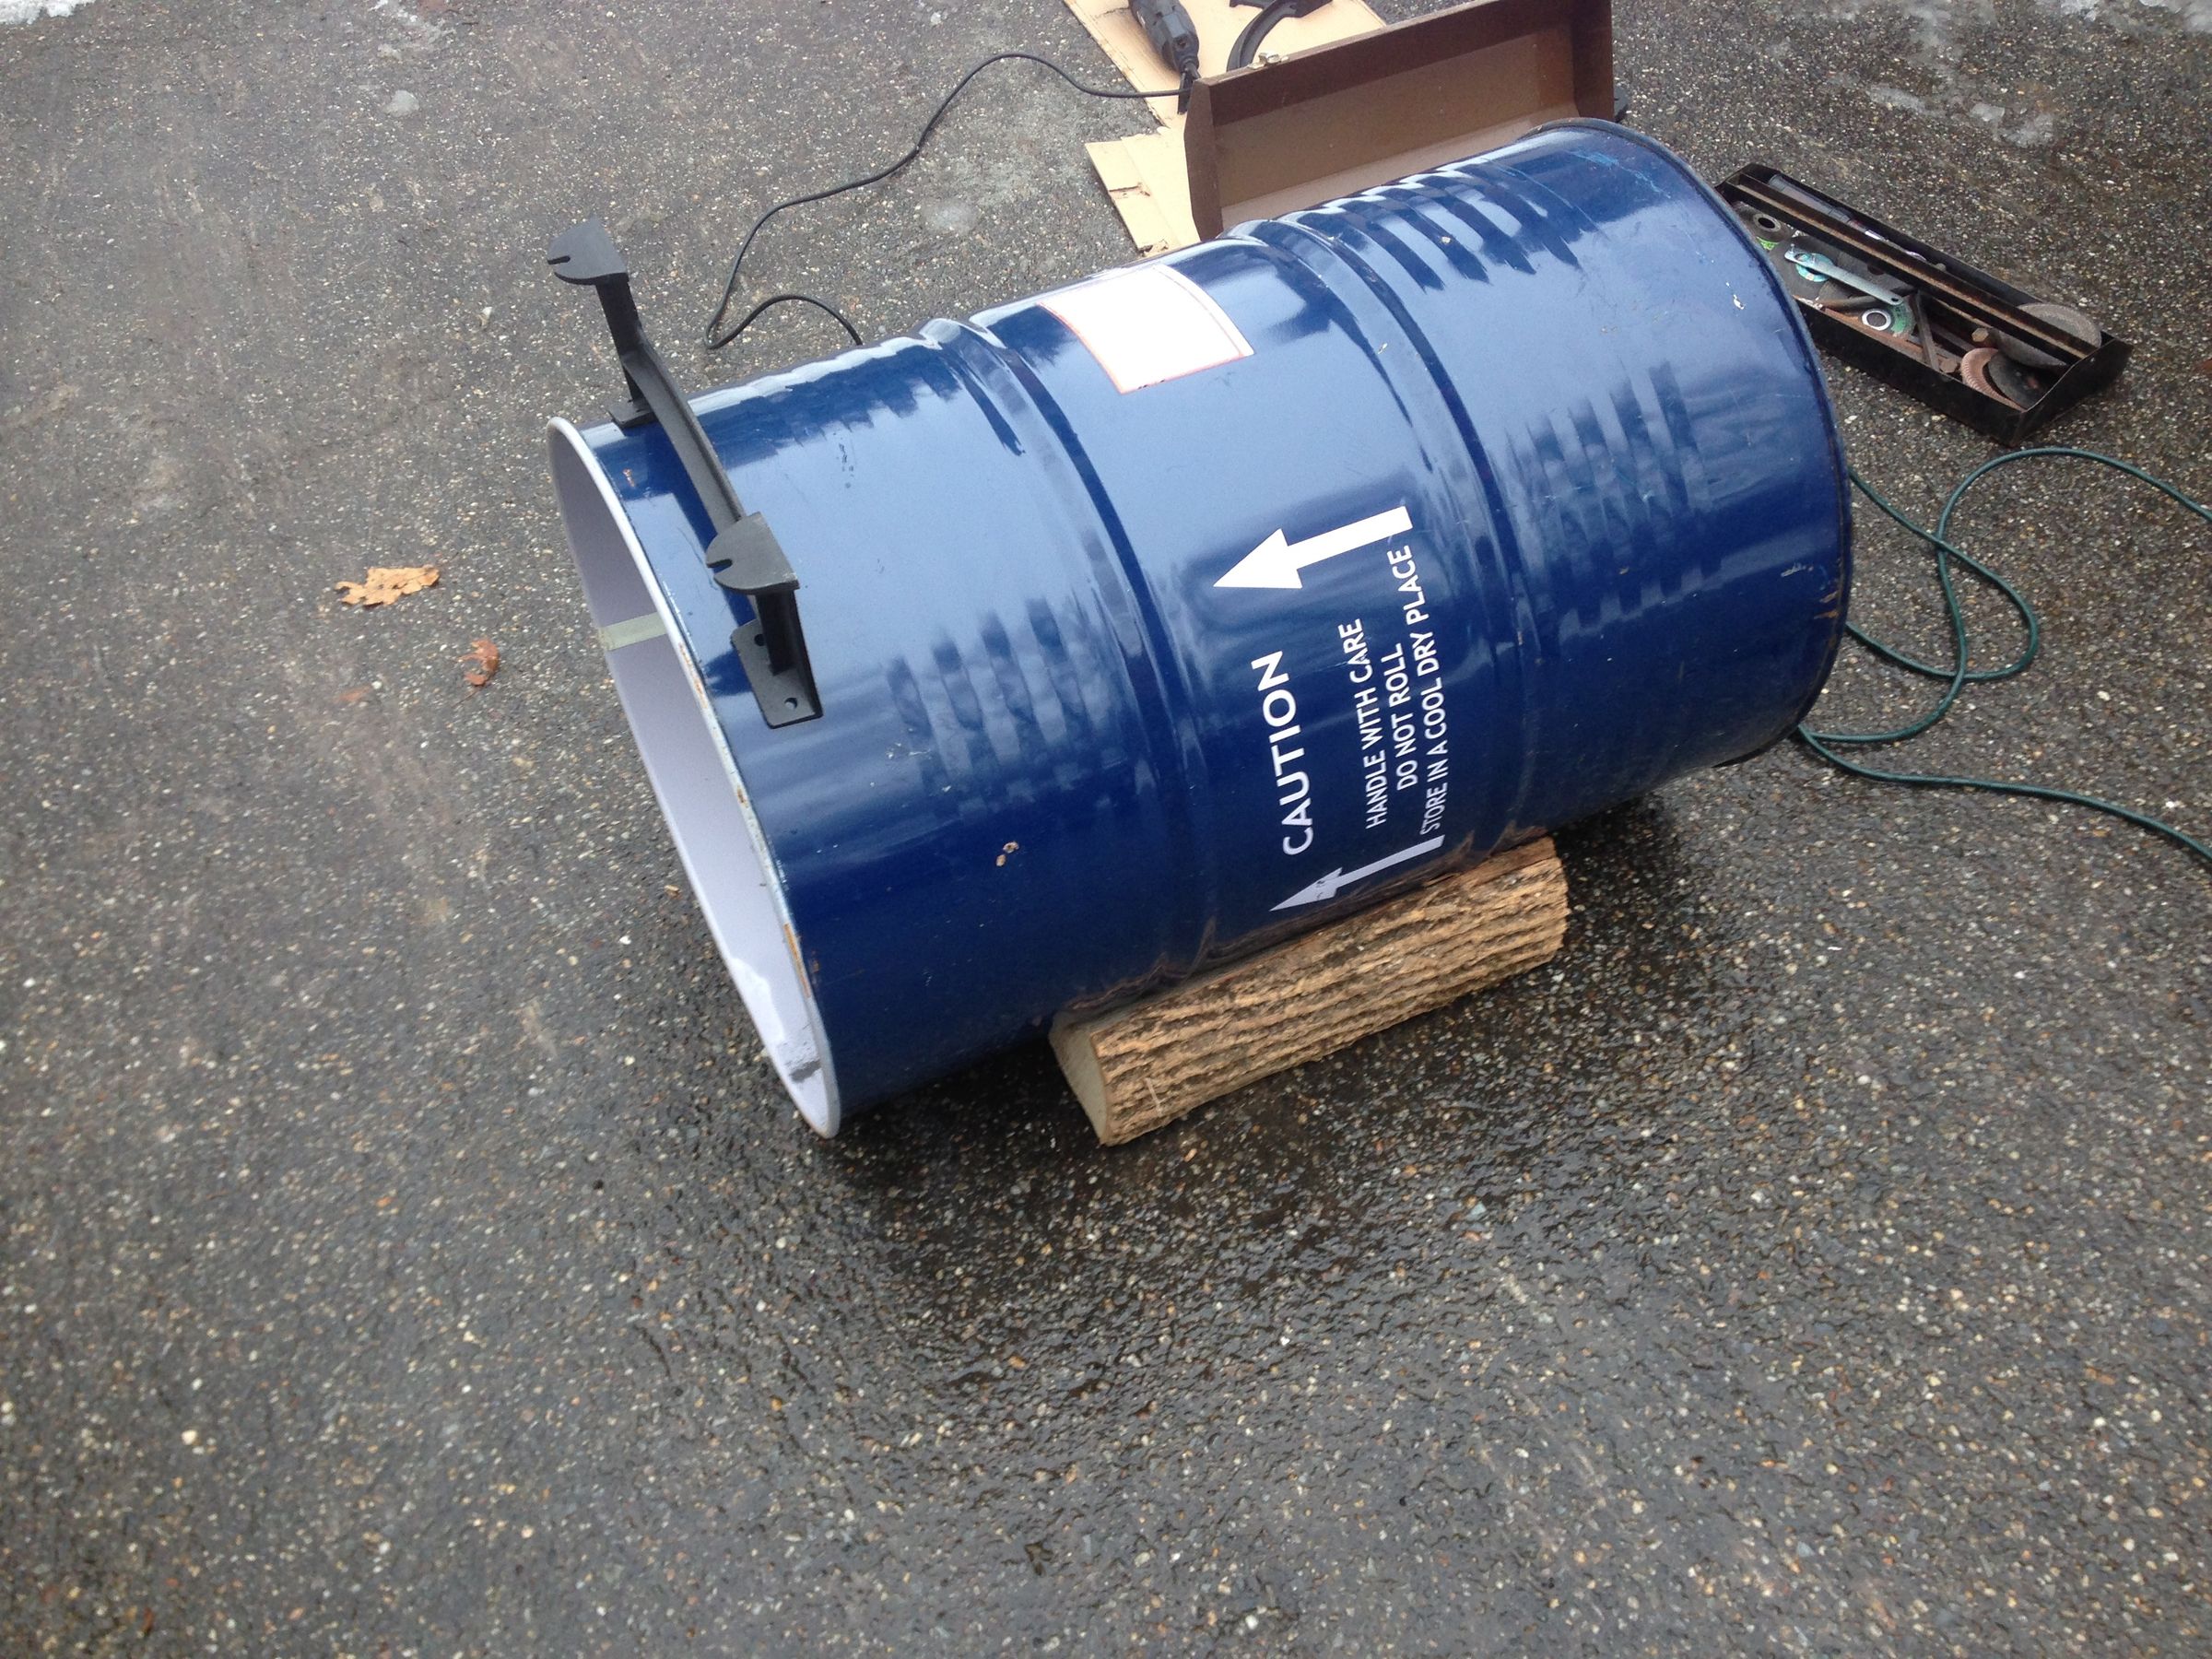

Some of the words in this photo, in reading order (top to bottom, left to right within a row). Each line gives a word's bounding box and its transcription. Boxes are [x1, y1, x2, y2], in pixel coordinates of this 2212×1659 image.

[1386, 545, 1430, 626] PLACE
[1337, 618, 1373, 683] CARE
[1381, 642, 1411, 708] ROLL
[1409, 631, 1440, 677] DRY
[1354, 687, 1382, 750] WITH
[1391, 712, 1417, 758] NOT
[1420, 677, 1448, 740] COOL
[1251, 650, 1313, 856] CAUTION
[1396, 759, 1418, 791] DO
[1426, 739, 1449, 756] A
[1427, 759, 1449, 782] IN
[1365, 749, 1388, 830] HANDLE
[1419, 782, 1448, 835] STORE
